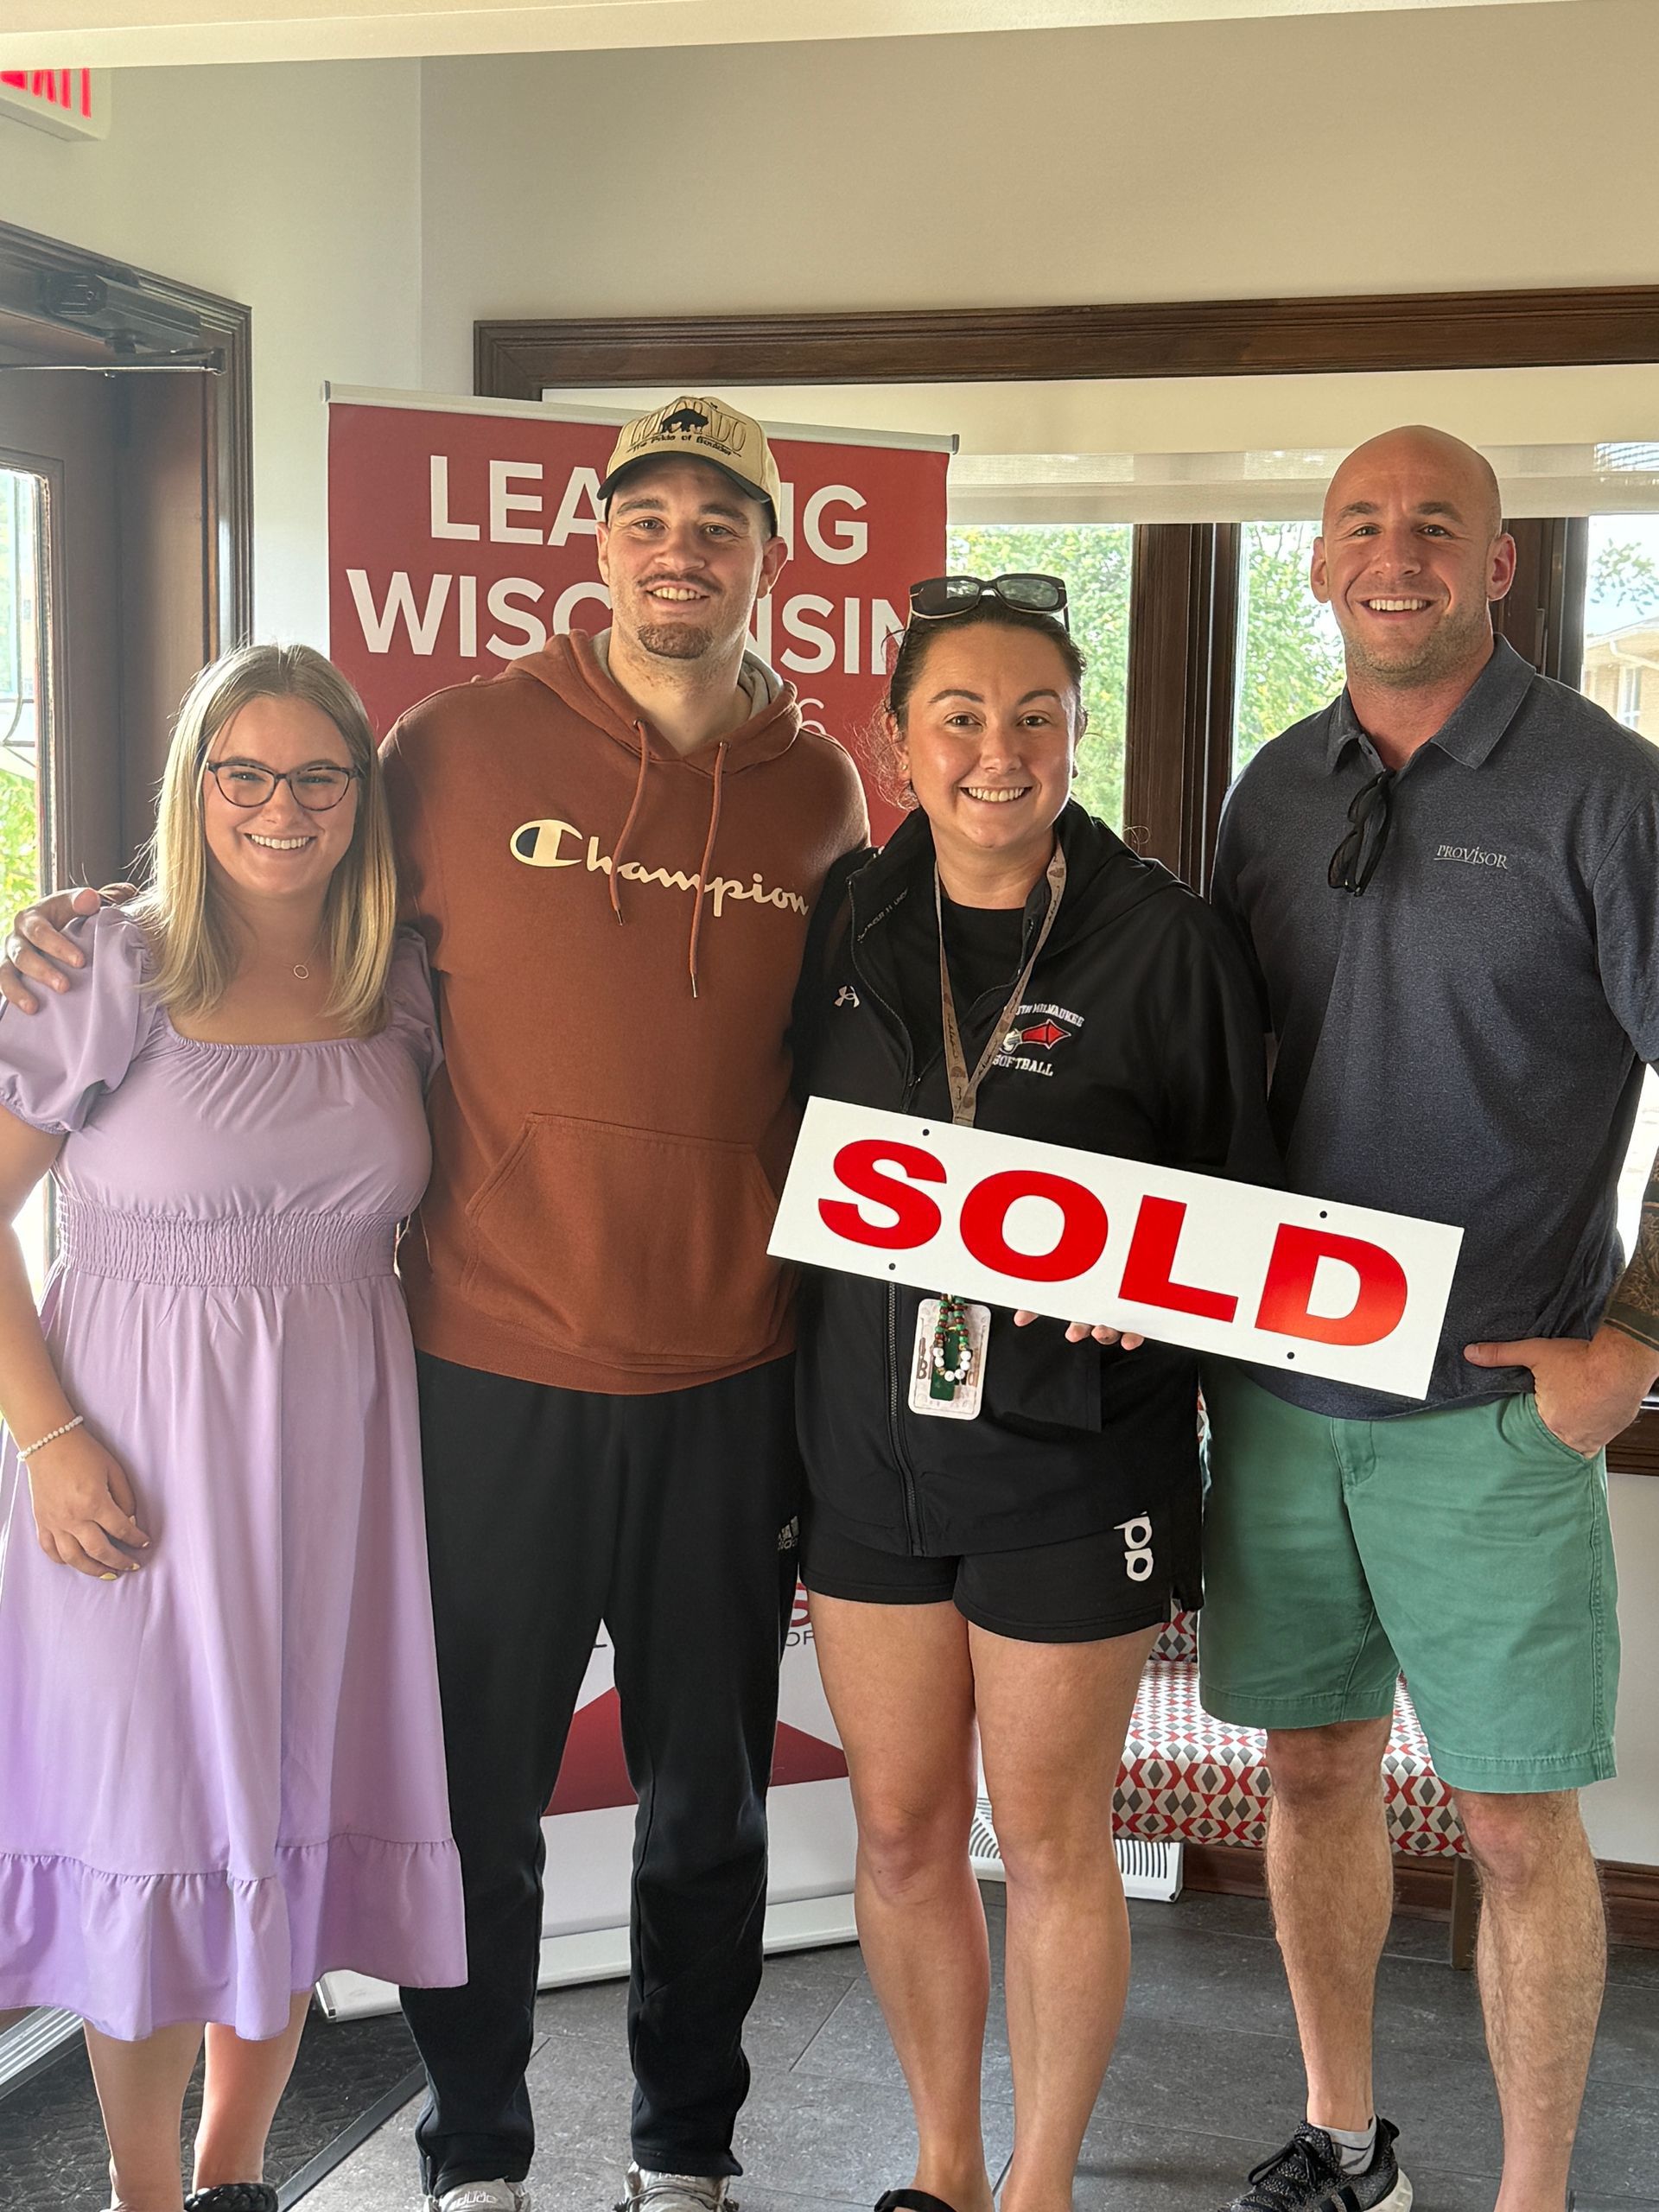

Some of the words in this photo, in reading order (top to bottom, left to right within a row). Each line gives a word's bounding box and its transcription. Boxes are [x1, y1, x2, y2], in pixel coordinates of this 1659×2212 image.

[430, 454, 868, 564] LEAG
[346, 569, 906, 675] WISCSIN
[509, 819, 809, 917] Champion
[993, 1054, 1053, 1077] SOFTBALL
[1033, 1002, 1084, 1027] MILWAUKEE
[817, 1139, 1408, 1347] SOLD
